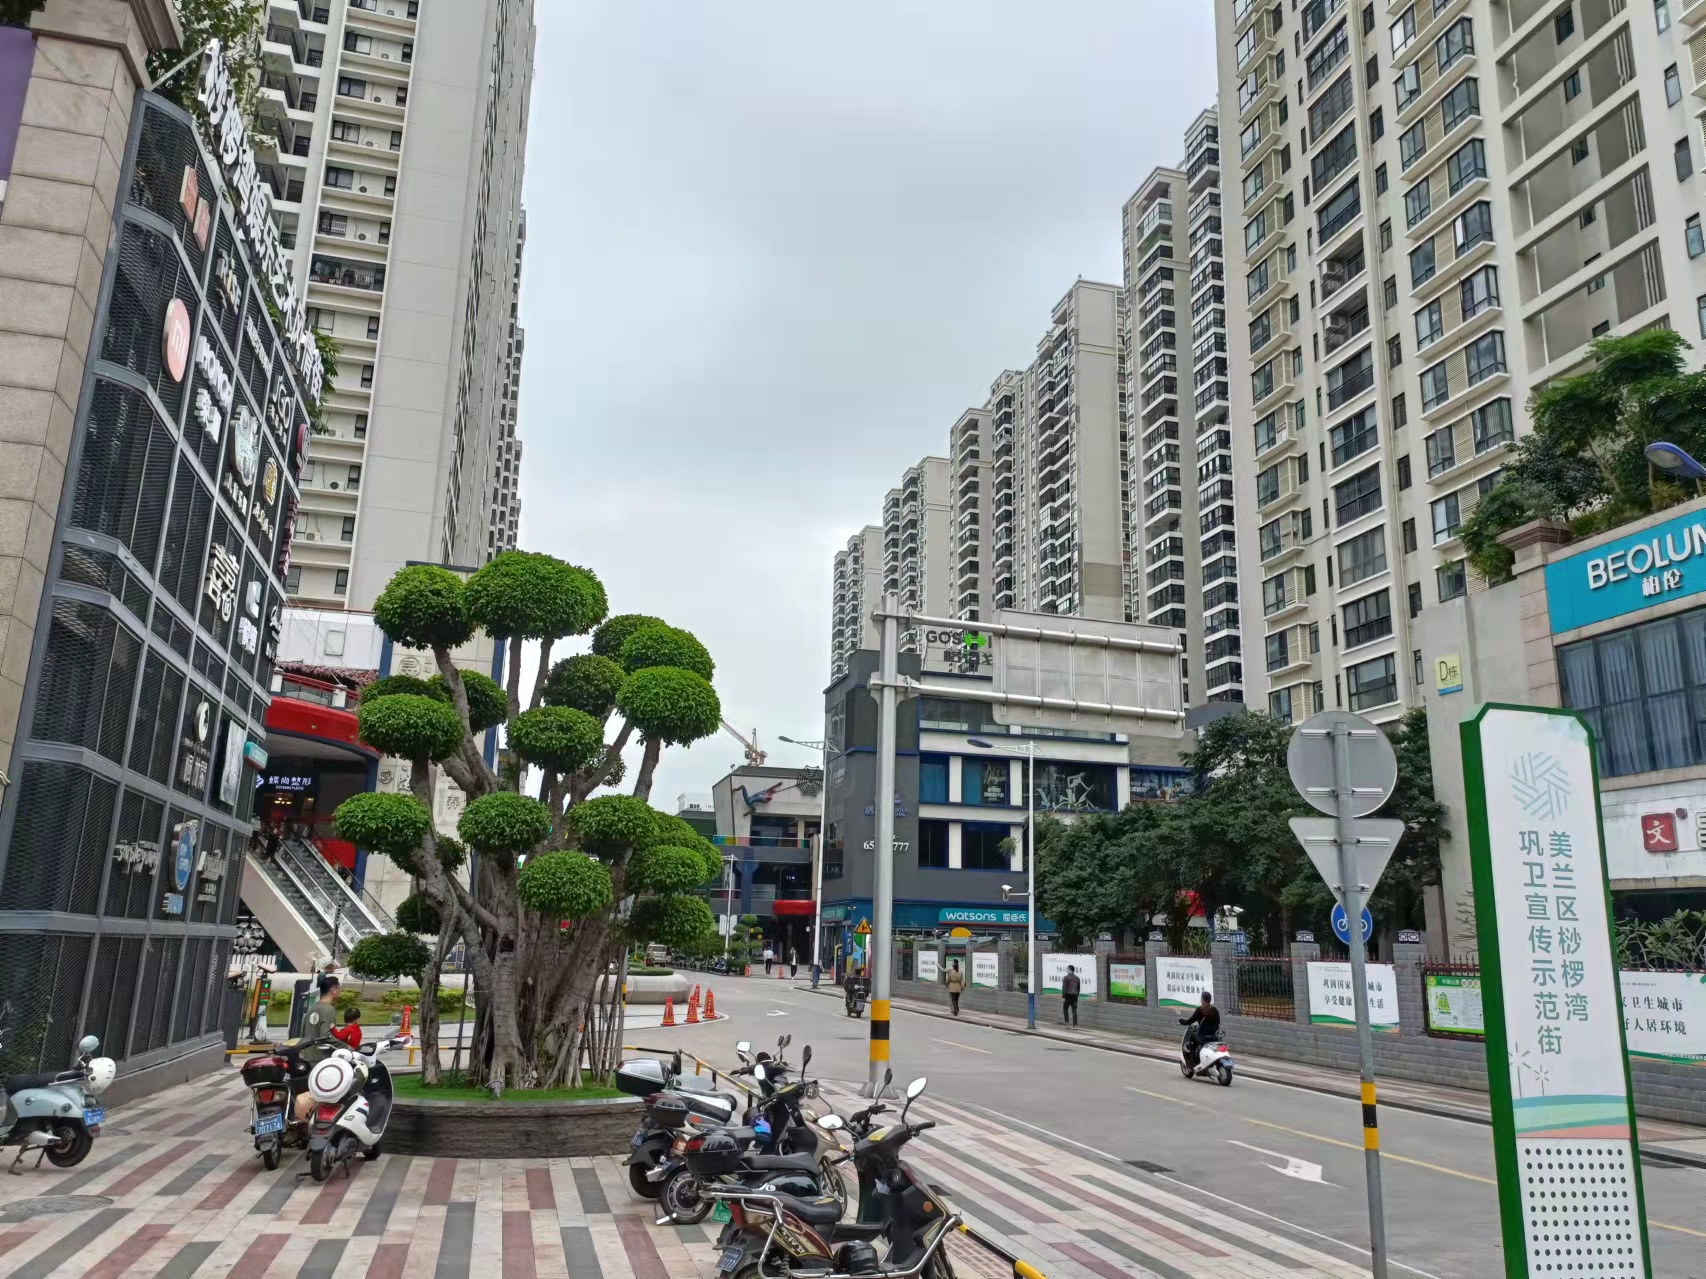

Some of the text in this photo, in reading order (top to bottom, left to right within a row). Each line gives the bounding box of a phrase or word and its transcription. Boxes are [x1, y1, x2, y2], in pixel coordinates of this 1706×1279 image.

[1642, 568, 1682, 597] 柏伦
[1646, 820, 1672, 844] 文
[945, 911, 997, 921] watsons
[1002, 912, 1027, 922] 屈臣氏
[1548, 831, 1589, 1022] 美兰区桫椤湾
[1518, 831, 1562, 1055] 巩卫宣传示范街
[1323, 978, 1383, 992] 巩固国家城市
[1325, 995, 1384, 1009] 享受健康生活
